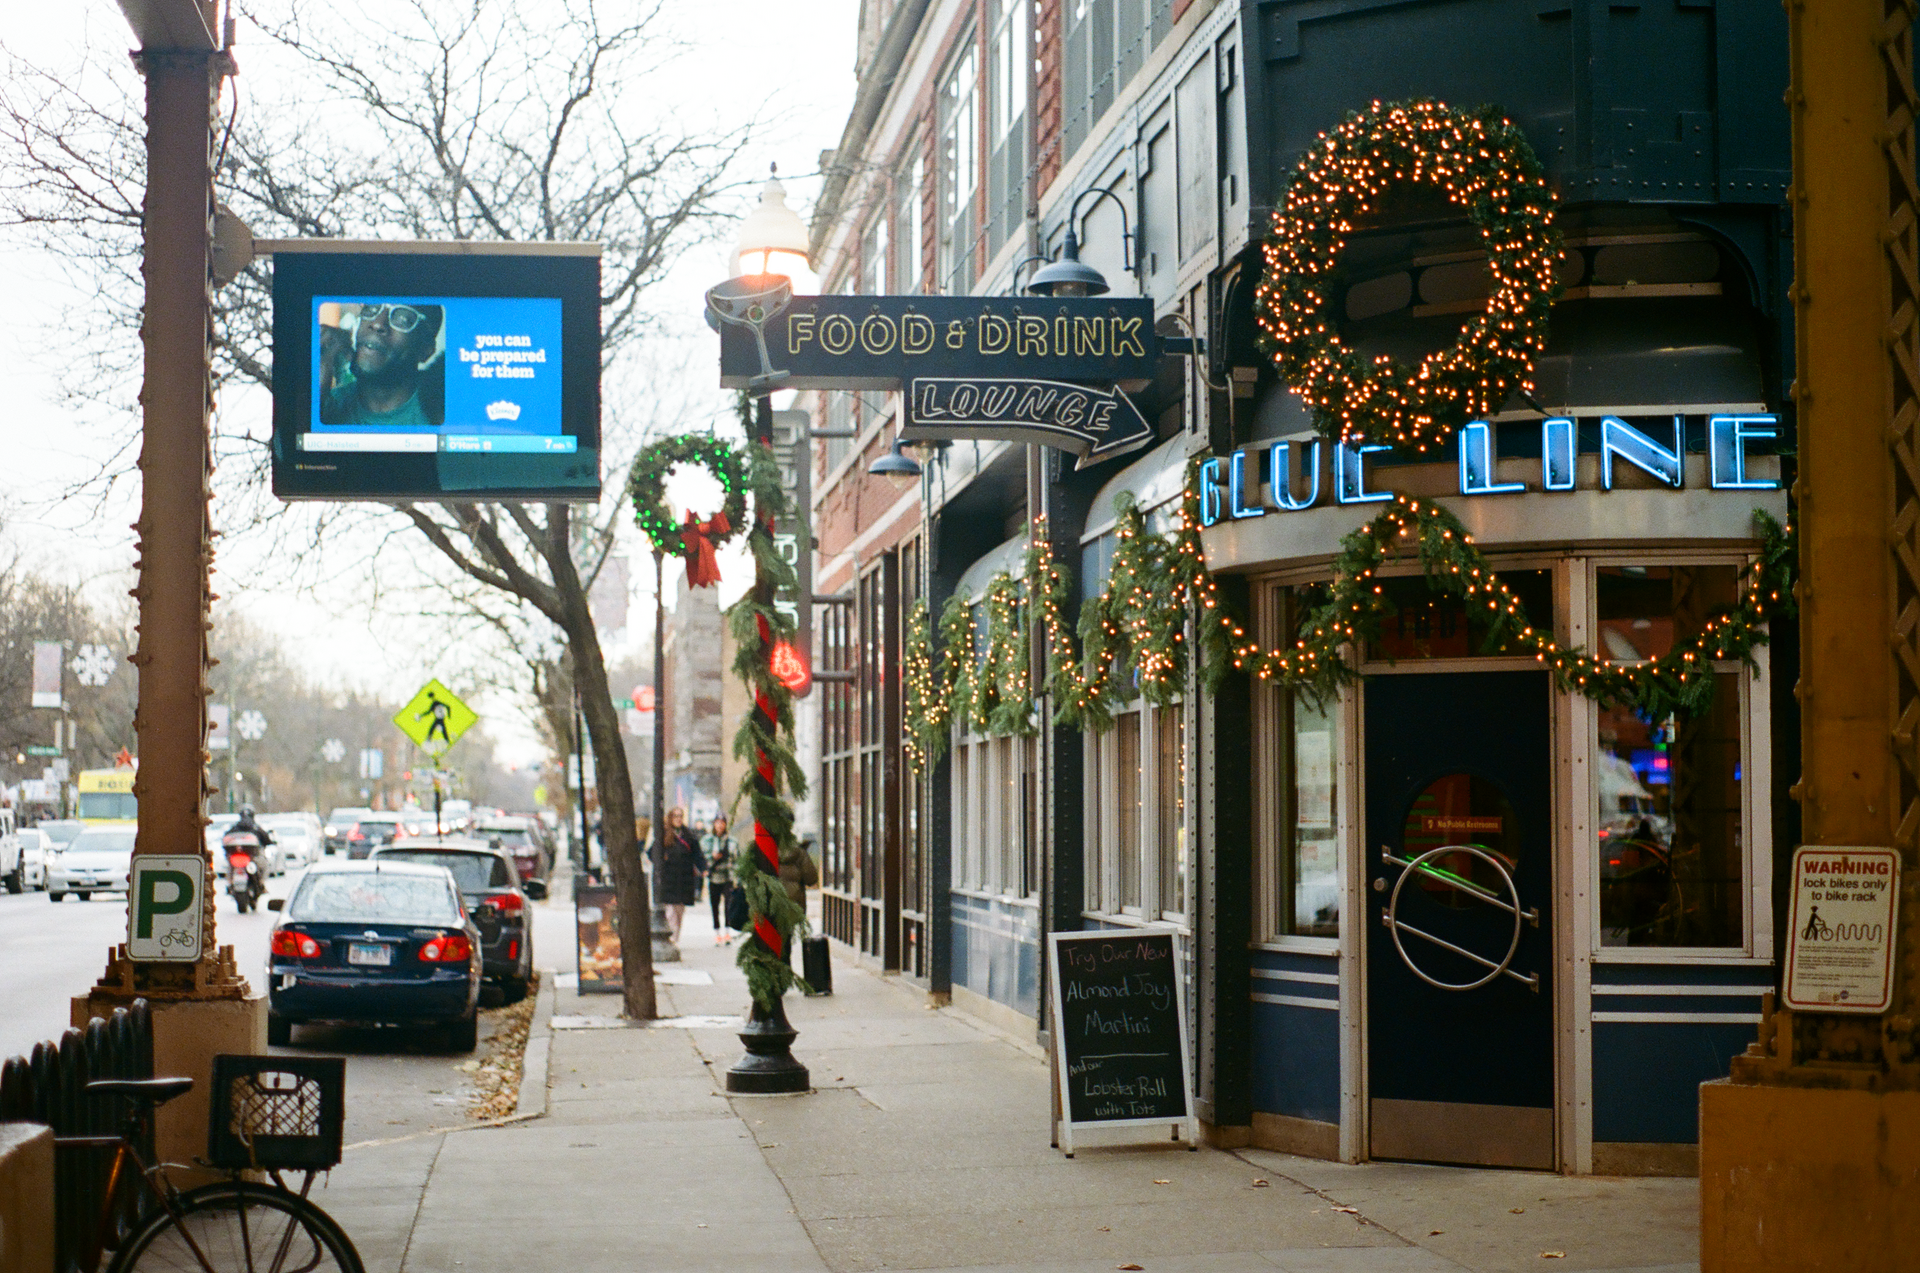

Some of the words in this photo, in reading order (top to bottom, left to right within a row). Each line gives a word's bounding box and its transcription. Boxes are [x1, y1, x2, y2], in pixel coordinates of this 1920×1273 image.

[475, 335, 503, 348] you
[504, 335, 531, 347] can
[787, 313, 936, 355] FOOD
[946, 320, 966, 349] &
[978, 314, 1146, 357] DRINK
[459, 347, 479, 362] be
[480, 348, 546, 365] prepared
[472, 363, 494, 378] for
[496, 364, 535, 378] them
[921, 383, 1118, 431] LOUNGE
[544, 439, 552, 449] 7
[1200, 436, 1394, 526] BLUE
[1458, 413, 1782, 494] LINE
[1804, 861, 1889, 875] WARNING
[1804, 878, 1826, 888] lock
[1830, 878, 1859, 889] bikes
[1862, 879, 1887, 892] only
[137, 870, 194, 939] P
[1811, 891, 1822, 900] to
[1826, 891, 1848, 901] bike
[1851, 891, 1876, 901] rack
[1065, 946, 1096, 972] Try
[1101, 943, 1132, 963] Our
[1135, 942, 1168, 961] New
[1066, 976, 1131, 1002] Almond
[1133, 972, 1171, 1011] Joy
[1084, 1009, 1151, 1036] Martini
[1069, 1059, 1087, 1076] And
[1084, 1076, 1136, 1096] Lobster
[1137, 1075, 1168, 1098] Roll
[1094, 1101, 1124, 1117] with
[1127, 1100, 1157, 1116] Tots
